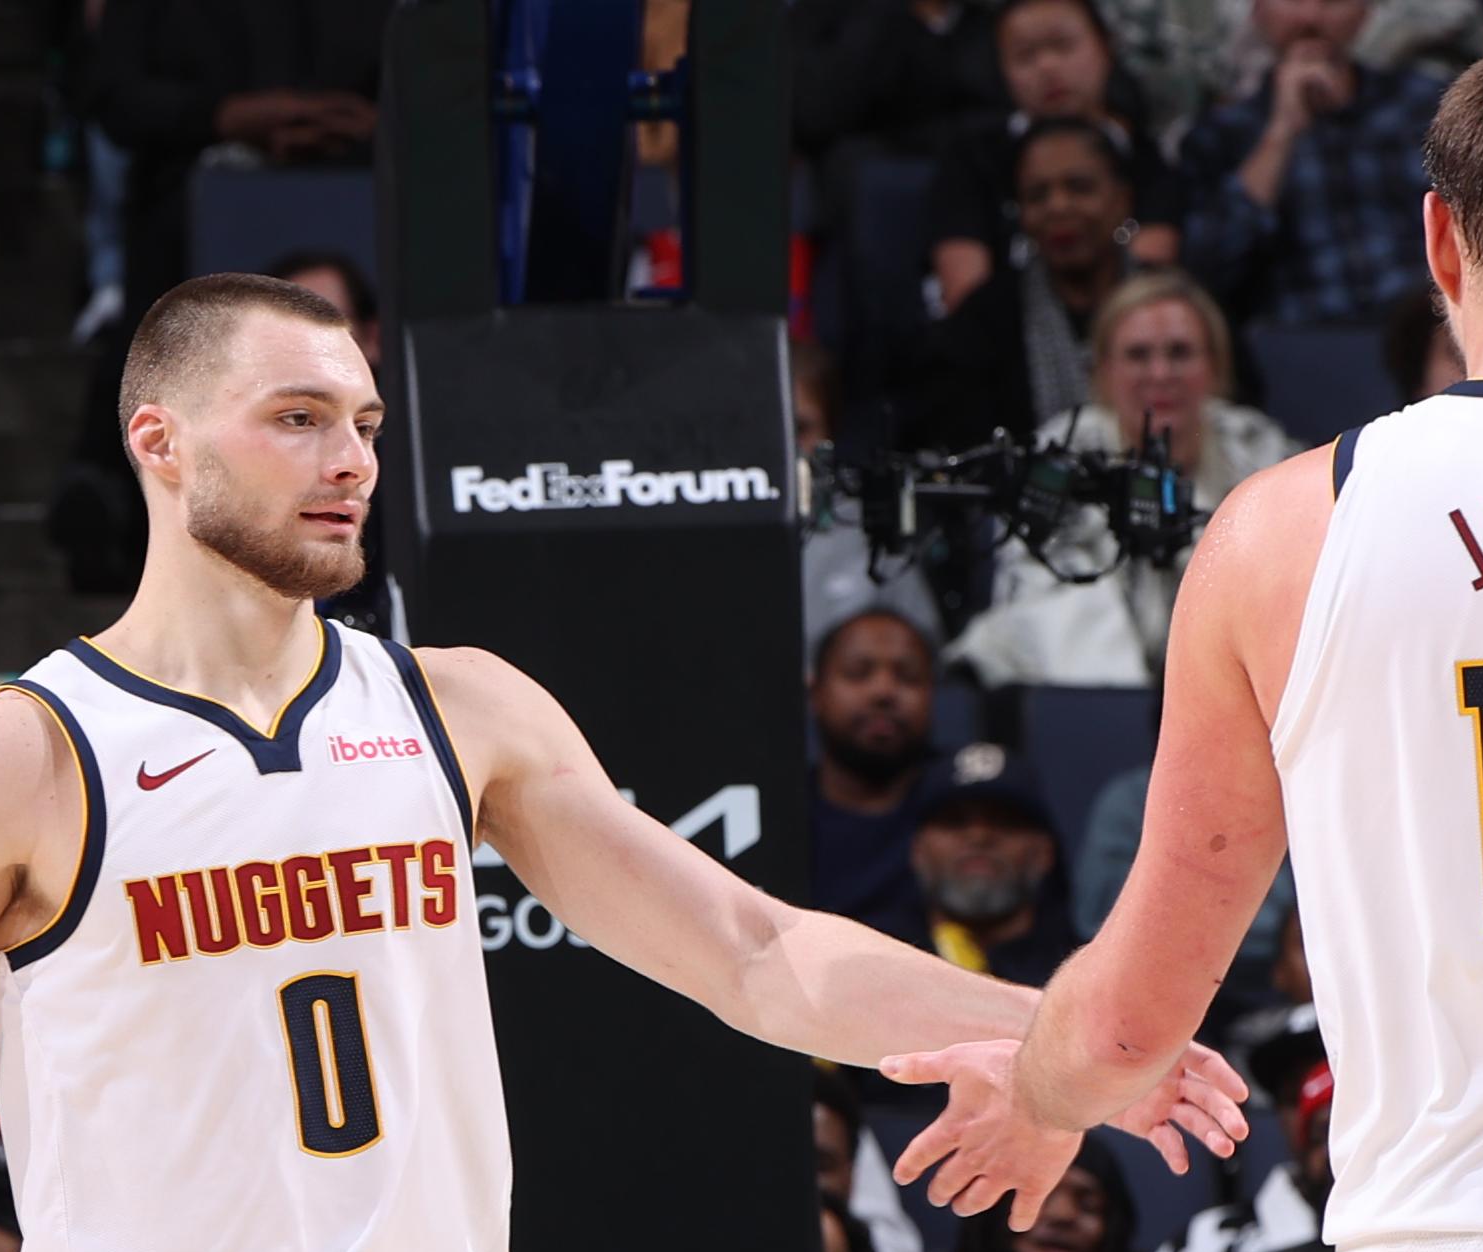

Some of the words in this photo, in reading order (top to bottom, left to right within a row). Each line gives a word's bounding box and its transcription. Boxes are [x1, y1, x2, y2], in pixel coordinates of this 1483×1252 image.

[328, 736, 423, 762] ibotta
[122, 839, 459, 966] NUGGETS
[475, 893, 592, 950] GO
[275, 970, 385, 1159] 0
